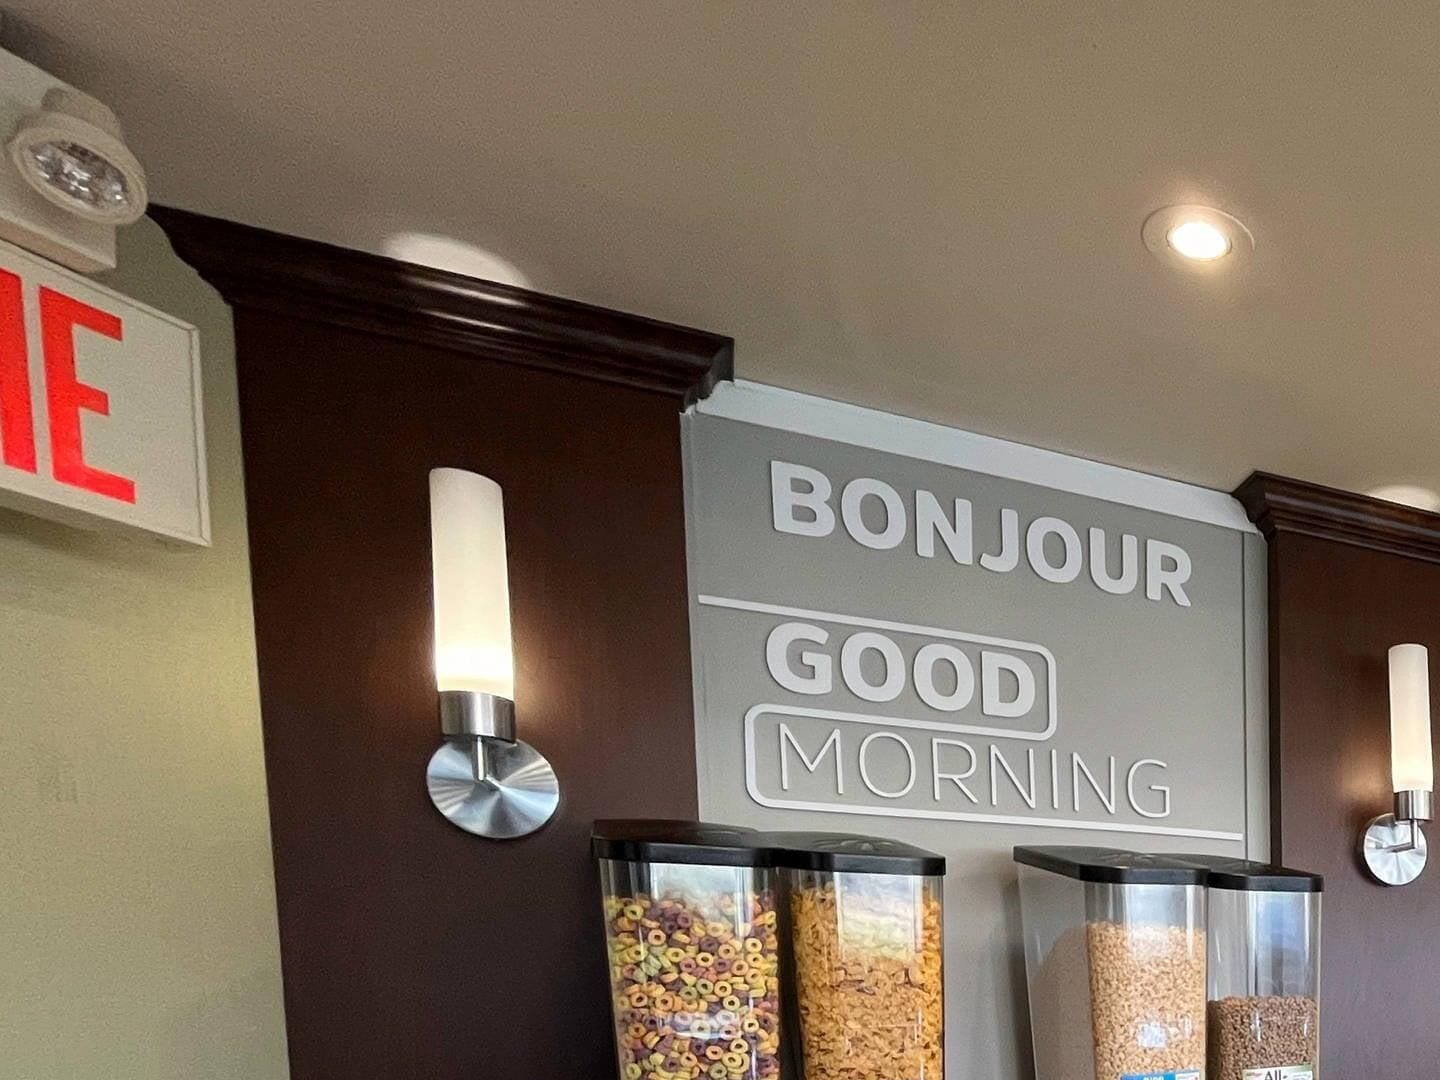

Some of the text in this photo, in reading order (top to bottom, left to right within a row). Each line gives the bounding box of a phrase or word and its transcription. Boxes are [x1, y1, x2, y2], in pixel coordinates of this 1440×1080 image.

[770, 460, 1193, 607] BONJOUR
[766, 622, 1036, 718] GOOD
[779, 722, 1171, 819] MORNING
